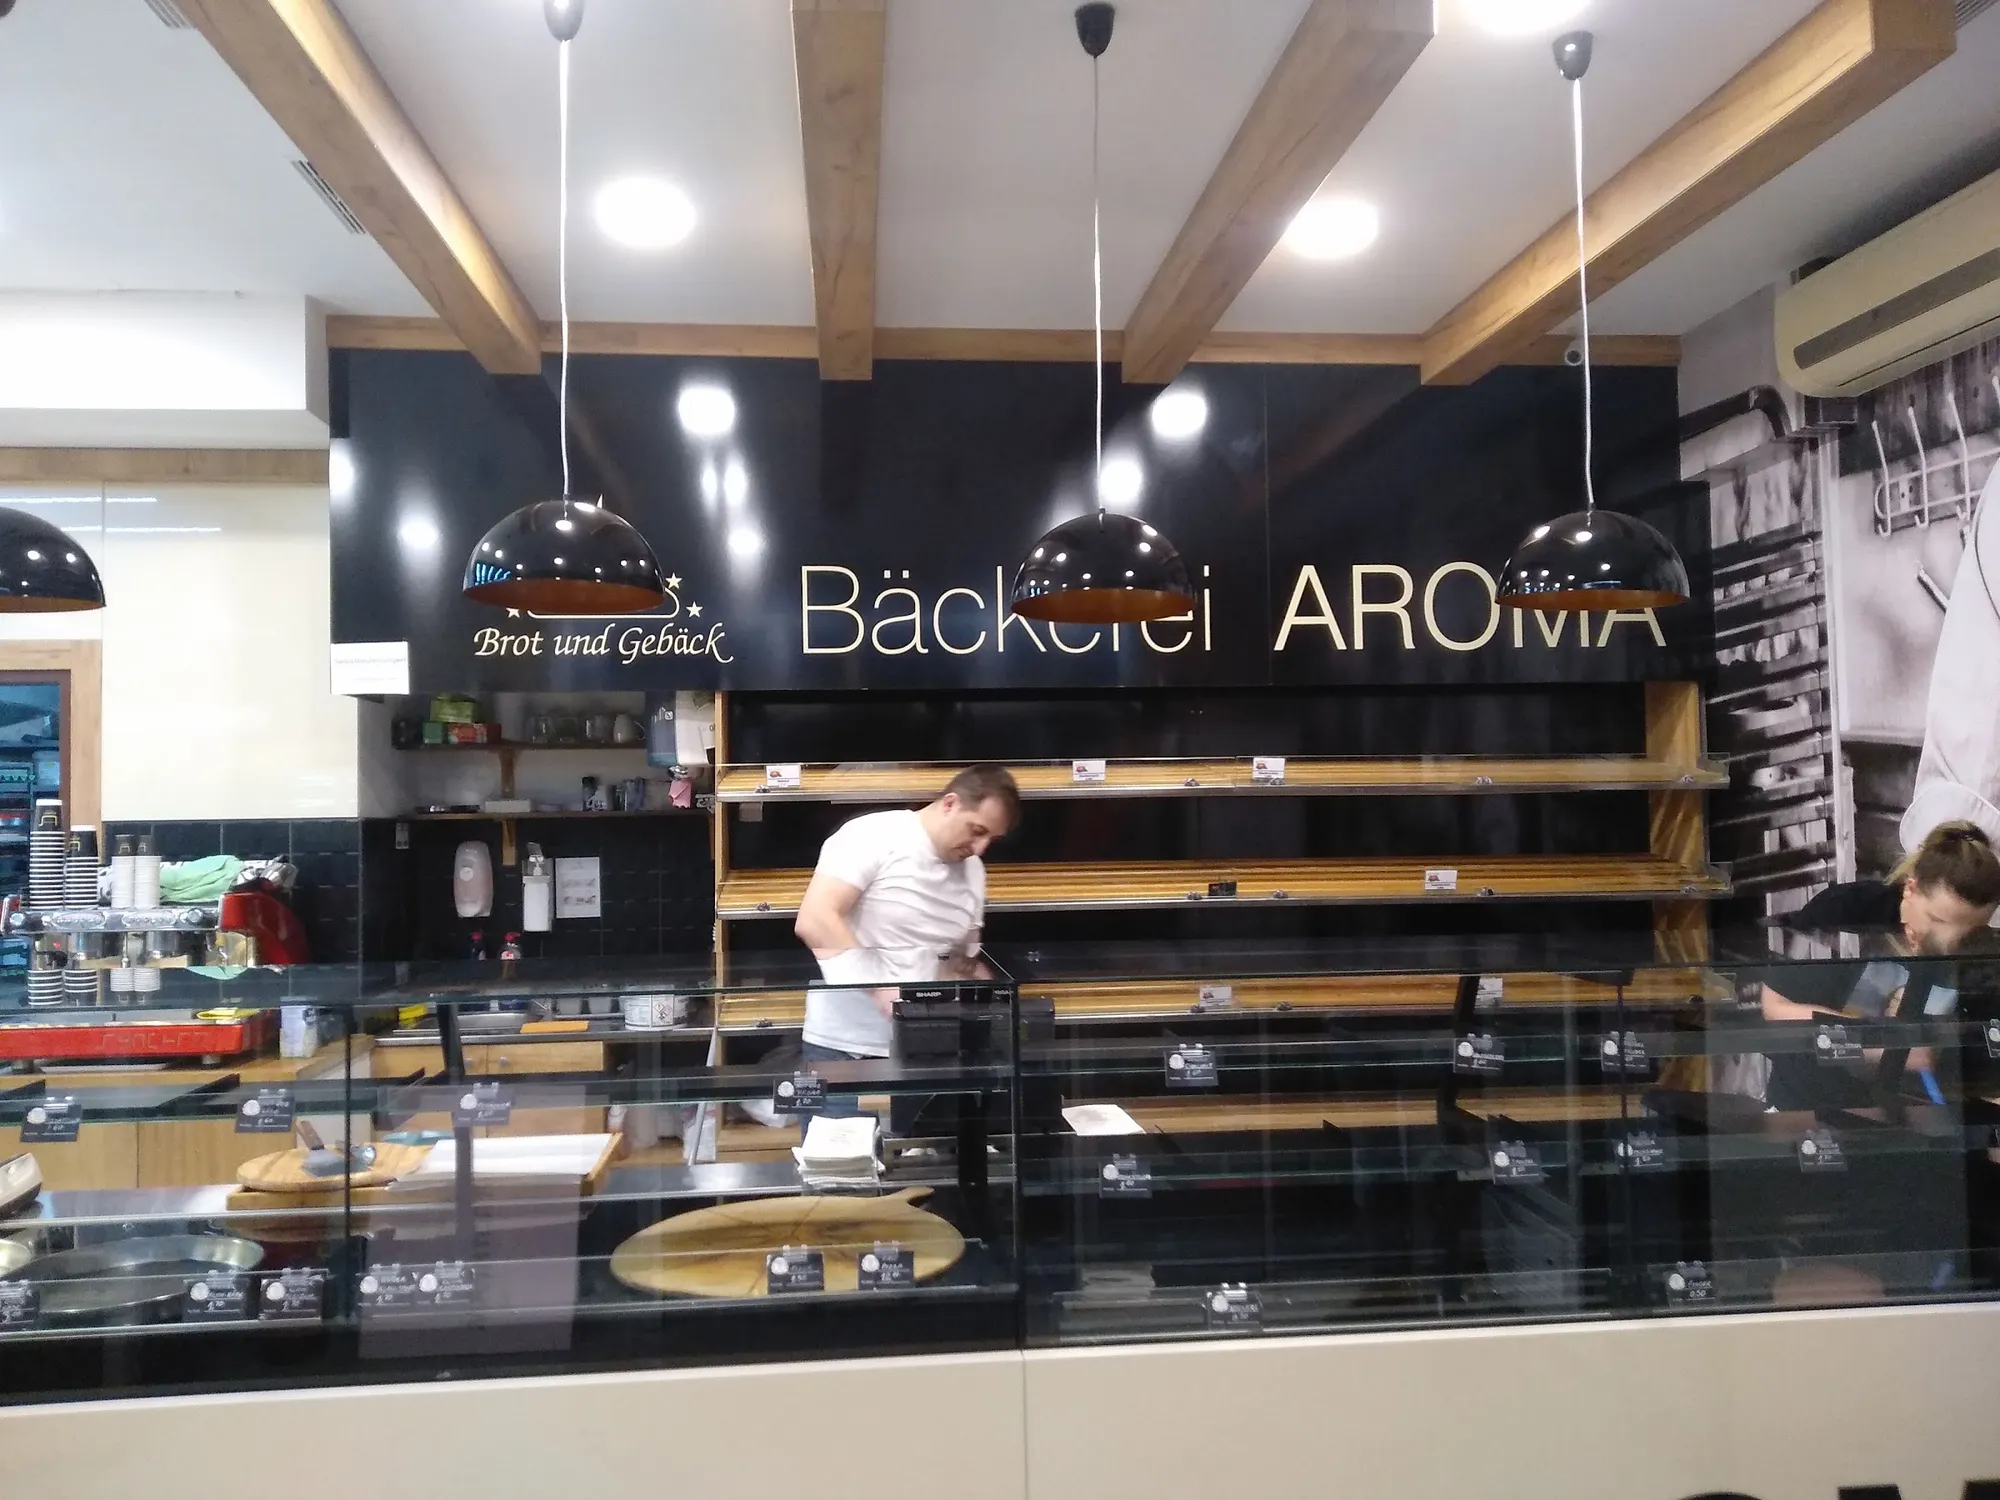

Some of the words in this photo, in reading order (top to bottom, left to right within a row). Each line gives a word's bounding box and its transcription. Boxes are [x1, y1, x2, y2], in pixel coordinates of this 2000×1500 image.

[473, 627, 545, 657] Brot
[553, 623, 617, 656] und
[618, 622, 735, 665] Gebäck
